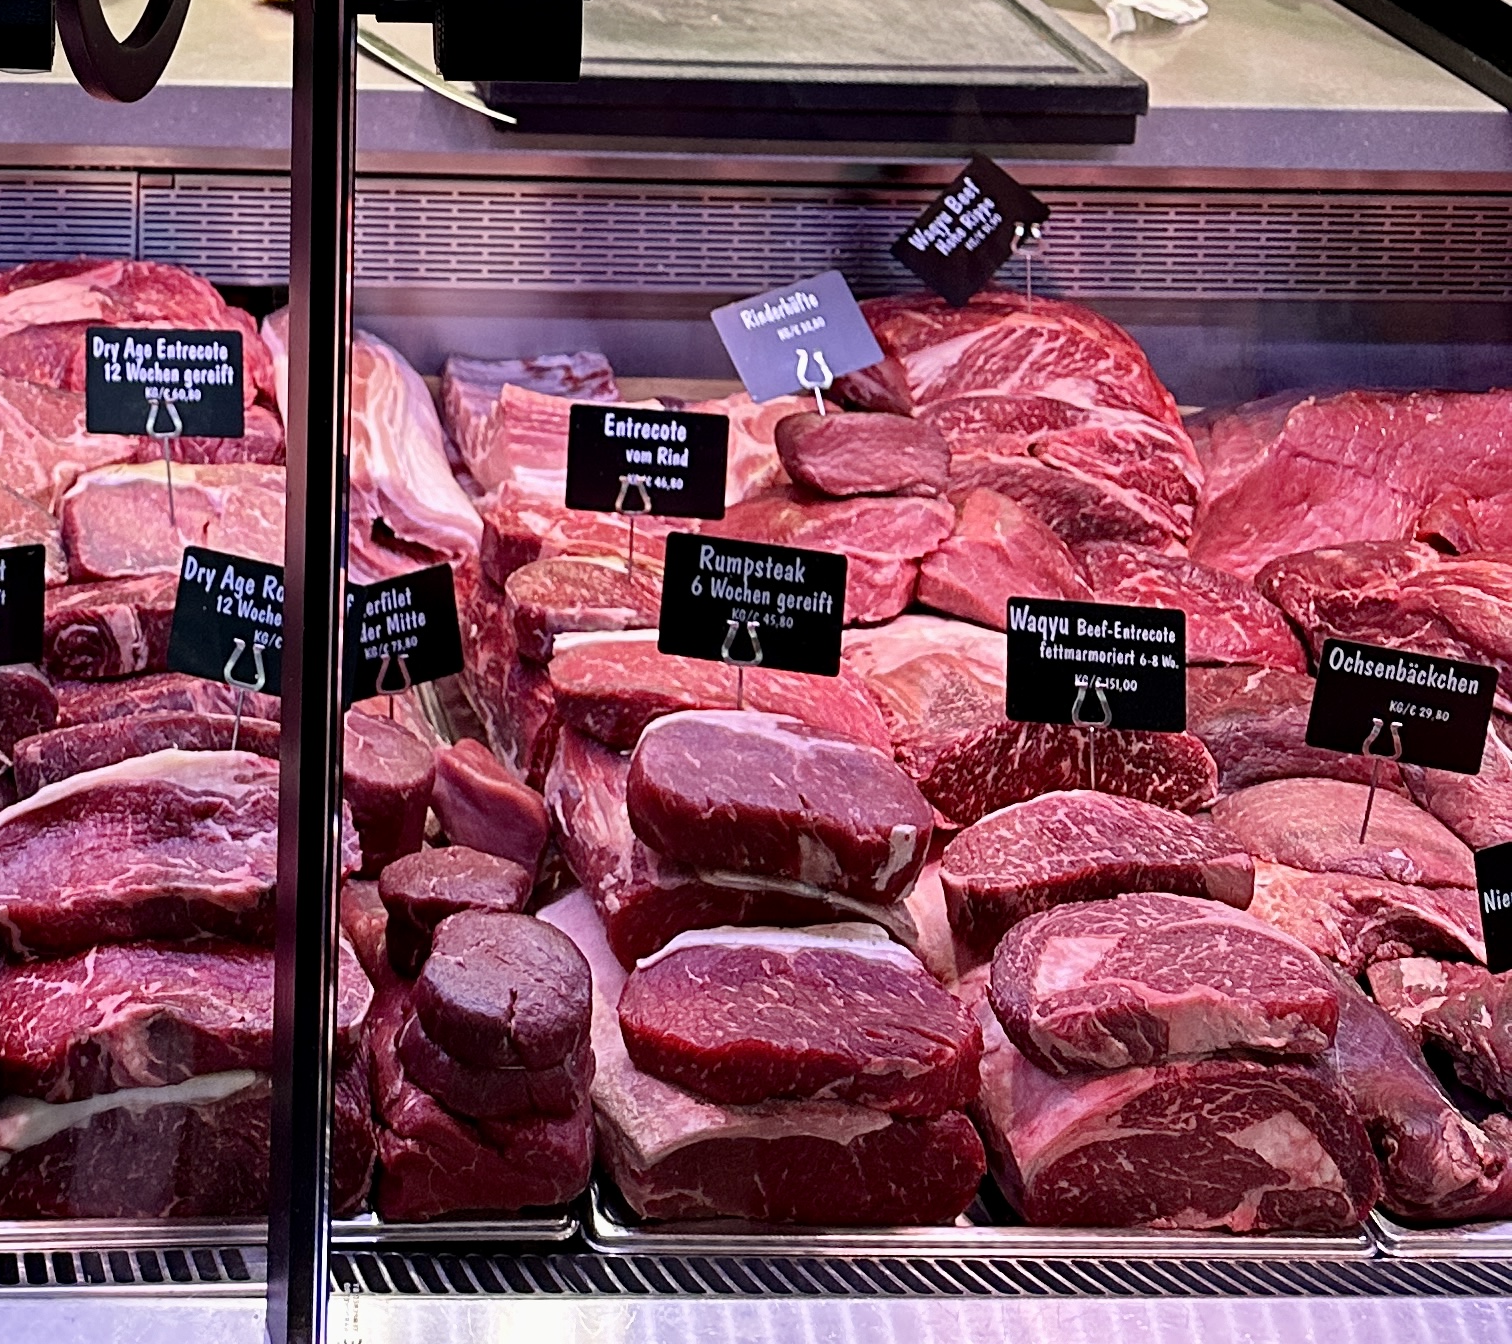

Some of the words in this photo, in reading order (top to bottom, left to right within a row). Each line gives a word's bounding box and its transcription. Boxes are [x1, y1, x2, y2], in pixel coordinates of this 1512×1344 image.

[740, 292, 819, 330] Rinderhüfte
[92, 335, 120, 364] Dry
[123, 336, 153, 362] Age
[156, 337, 229, 361] Entrecote
[104, 362, 122, 383] 12
[125, 361, 180, 383] Wochen
[183, 363, 235, 388] gereift
[604, 412, 687, 442] Entrecote
[626, 448, 652, 464] vom
[656, 446, 689, 468] Rind
[184, 555, 215, 593] Dry
[220, 565, 255, 600] Age
[699, 544, 806, 586] Rumpsteak
[691, 575, 703, 596] 6
[711, 577, 771, 605] Wochen
[777, 591, 833, 614] gereift
[216, 595, 232, 615] 12
[237, 597, 283, 627] Woche
[386, 610, 426, 636] Mitte
[763, 613, 794, 629] 45,80
[1077, 618, 1176, 644] Beef-Entrecote
[1040, 641, 1135, 666] fettmarmoriert
[1139, 654, 1159, 667] 6-8
[1161, 654, 1180, 670] Wo.
[1329, 646, 1480, 695] Ochsenbäckchen
[1389, 699, 1417, 717] KG/€
[1419, 706, 1450, 722] 29,80
[1483, 888, 1512, 914] Nie
